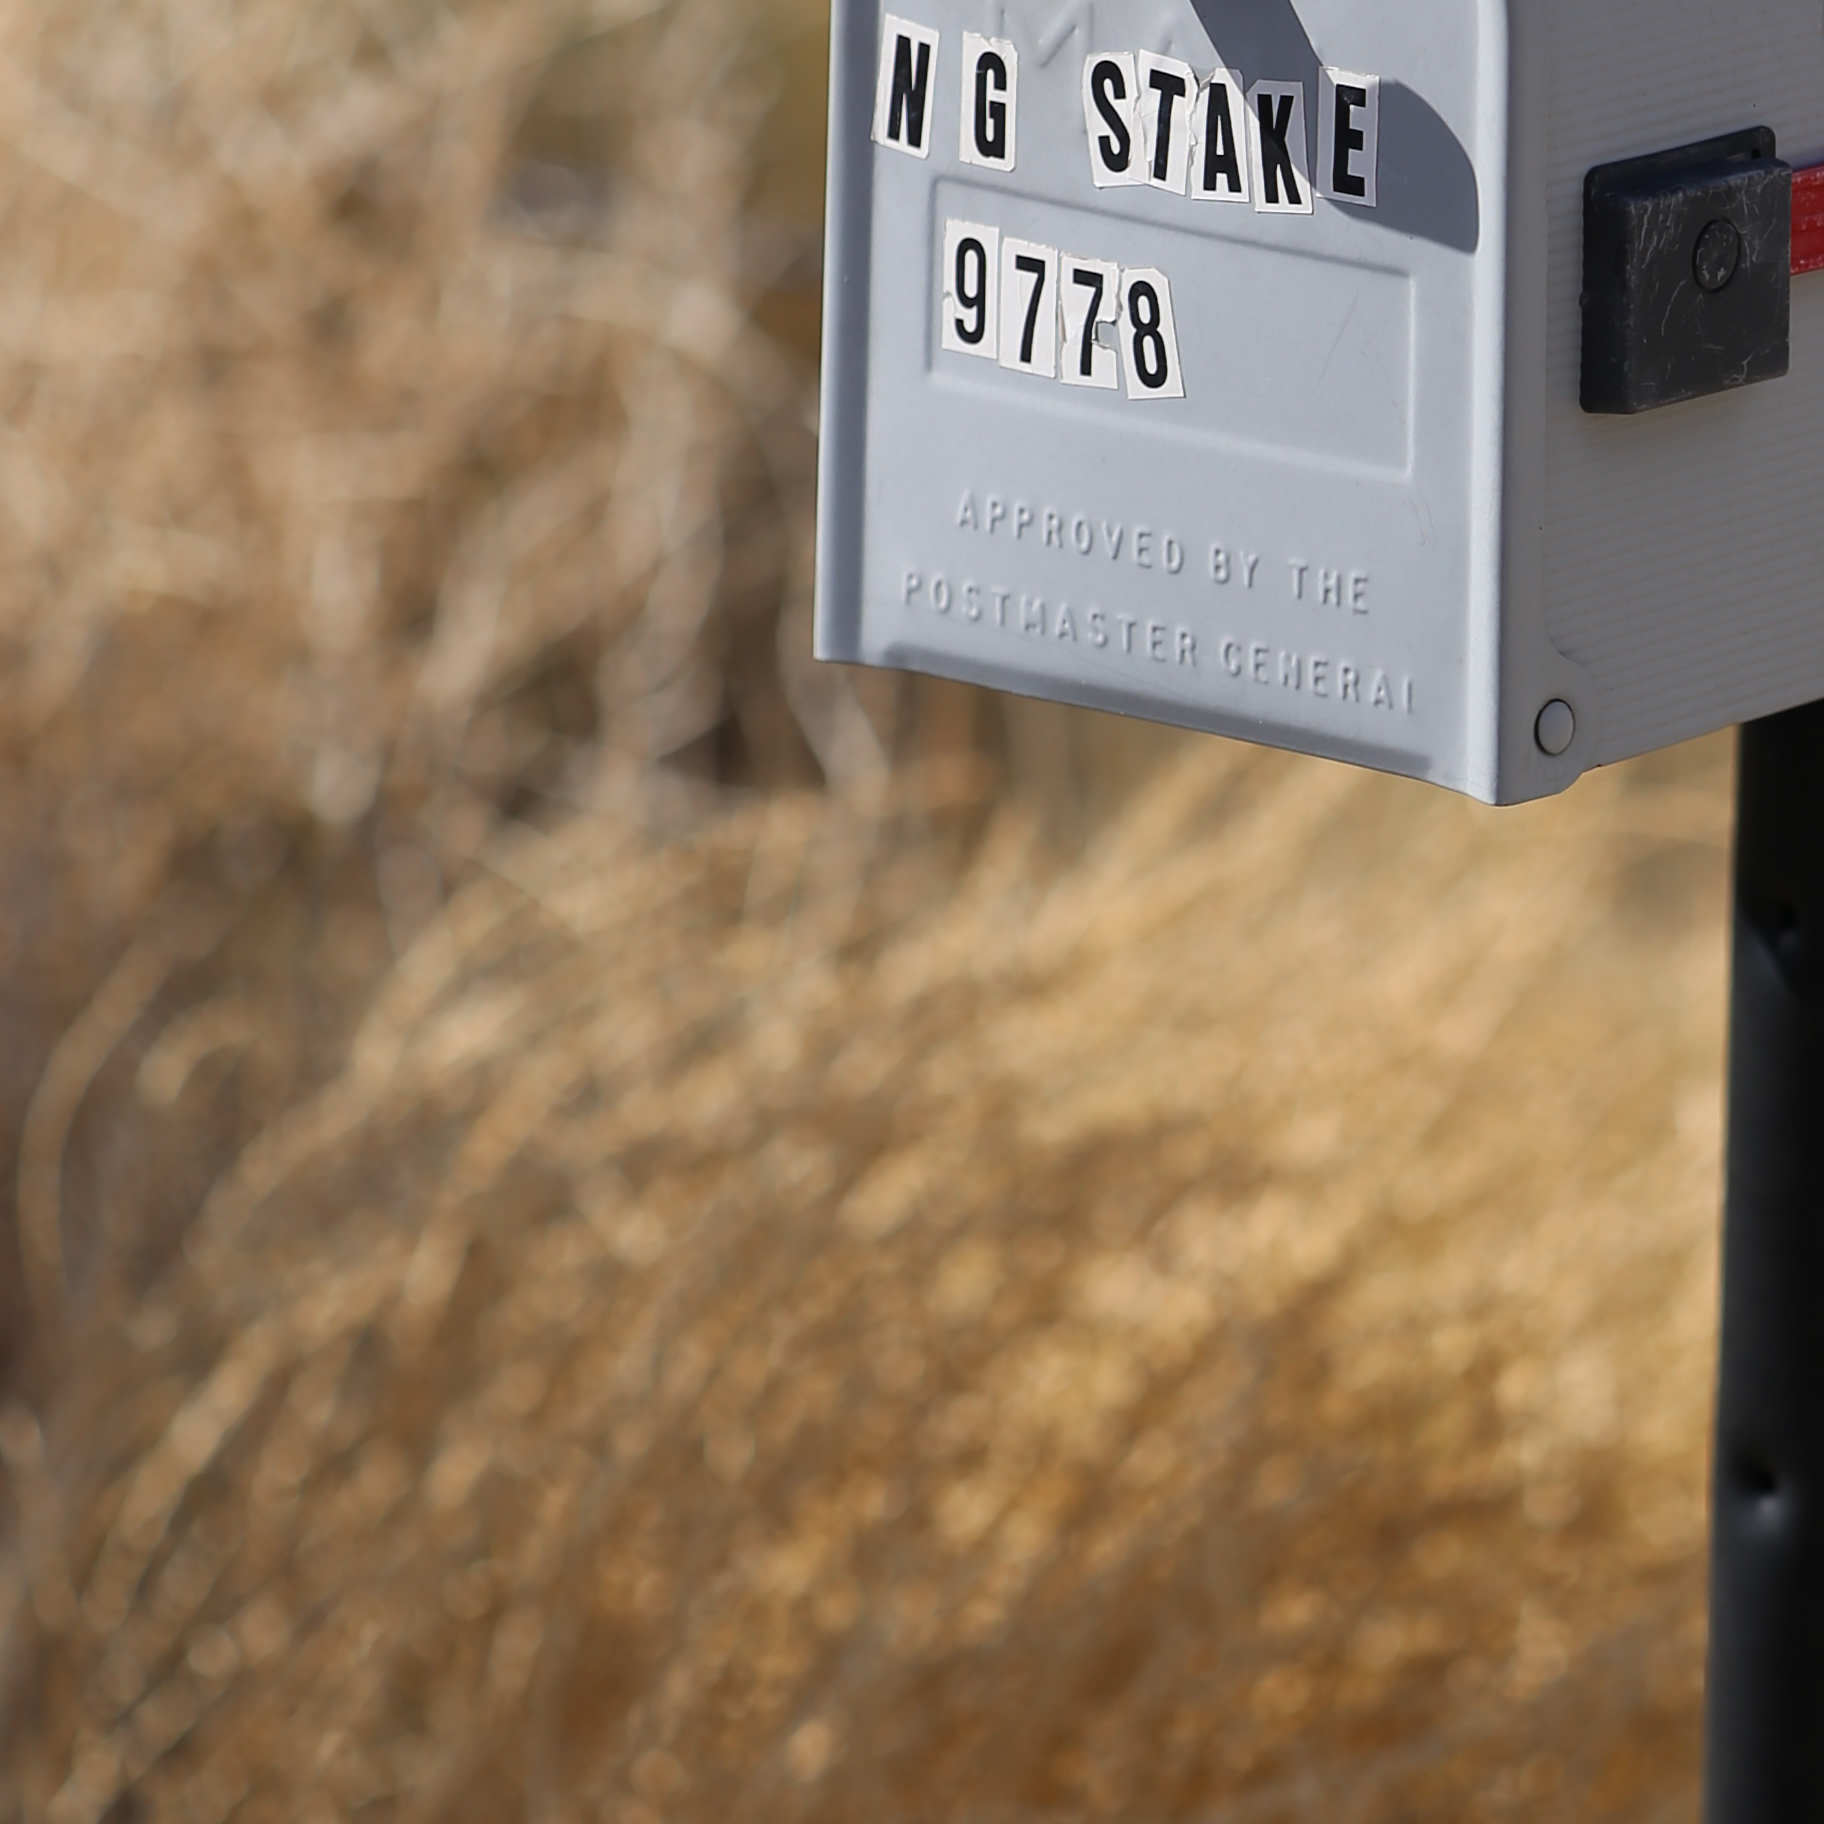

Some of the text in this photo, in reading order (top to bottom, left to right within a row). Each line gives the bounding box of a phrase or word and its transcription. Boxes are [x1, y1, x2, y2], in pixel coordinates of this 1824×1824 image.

[1091, 60, 1366, 196] STAKE
[955, 237, 1168, 388] 9778
[903, 571, 1197, 666] POSTMASTER
[957, 490, 1369, 616] APPROVED BY THE
